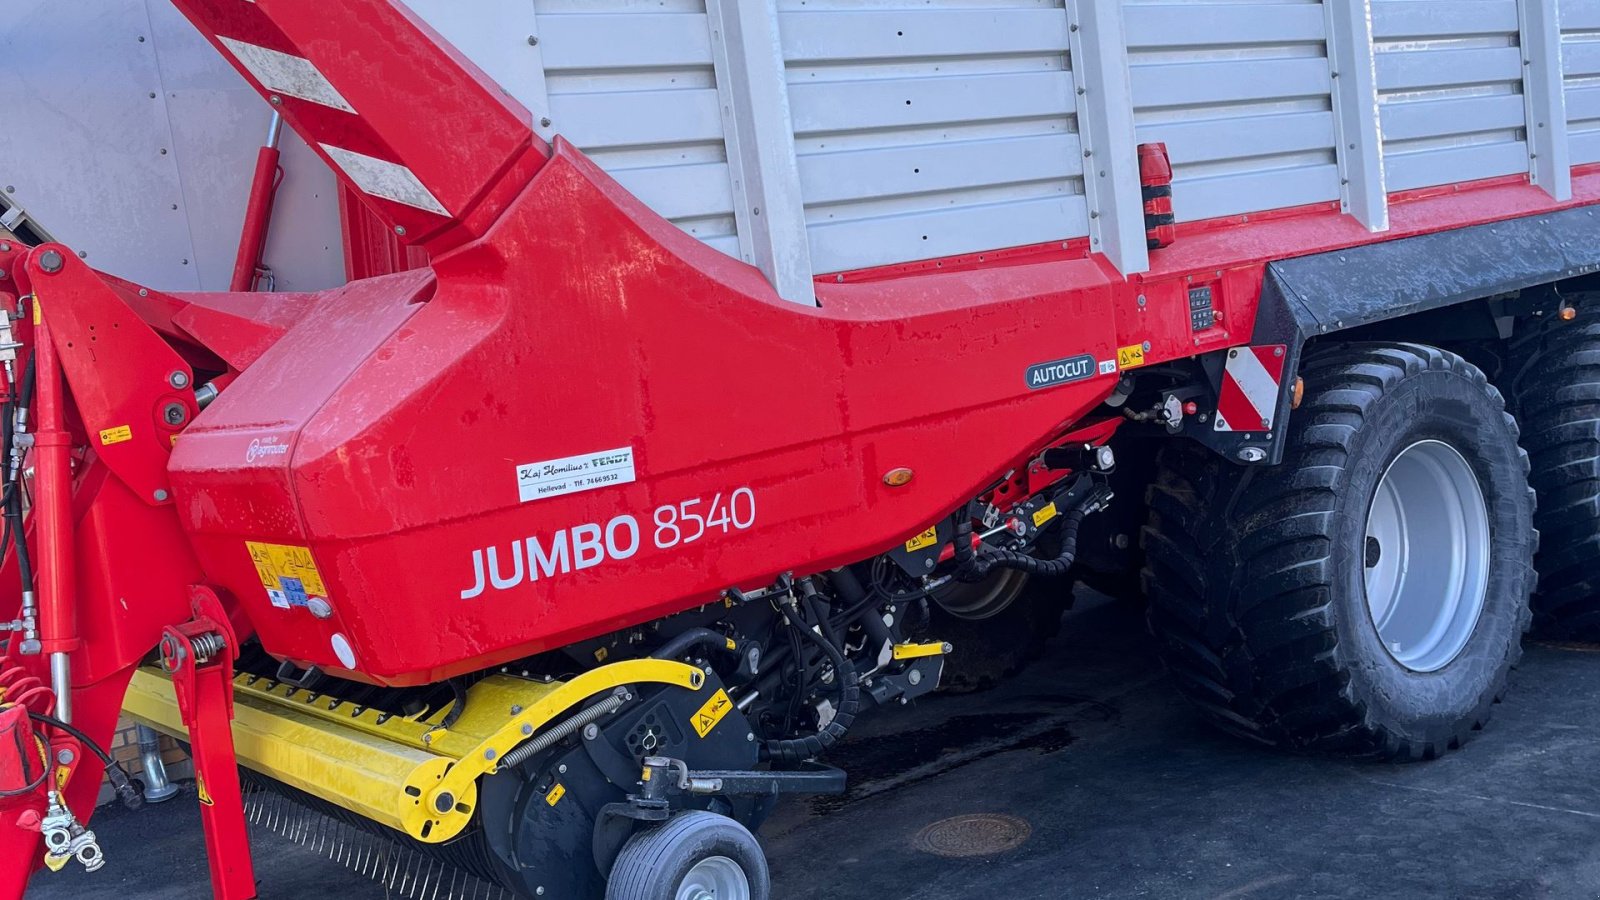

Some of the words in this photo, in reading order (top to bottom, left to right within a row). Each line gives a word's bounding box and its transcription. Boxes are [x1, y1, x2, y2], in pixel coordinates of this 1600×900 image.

[1033, 360, 1088, 384] AUTOCUT
[520, 469, 541, 480] Kaj
[543, 464, 583, 476] Homilius
[592, 453, 630, 467] FENDT
[538, 483, 566, 494] Hellevad
[574, 479, 585, 488] Tlf.
[586, 474, 618, 485] 74669532
[460, 514, 640, 600] JUMBO
[653, 486, 756, 549] 8540
